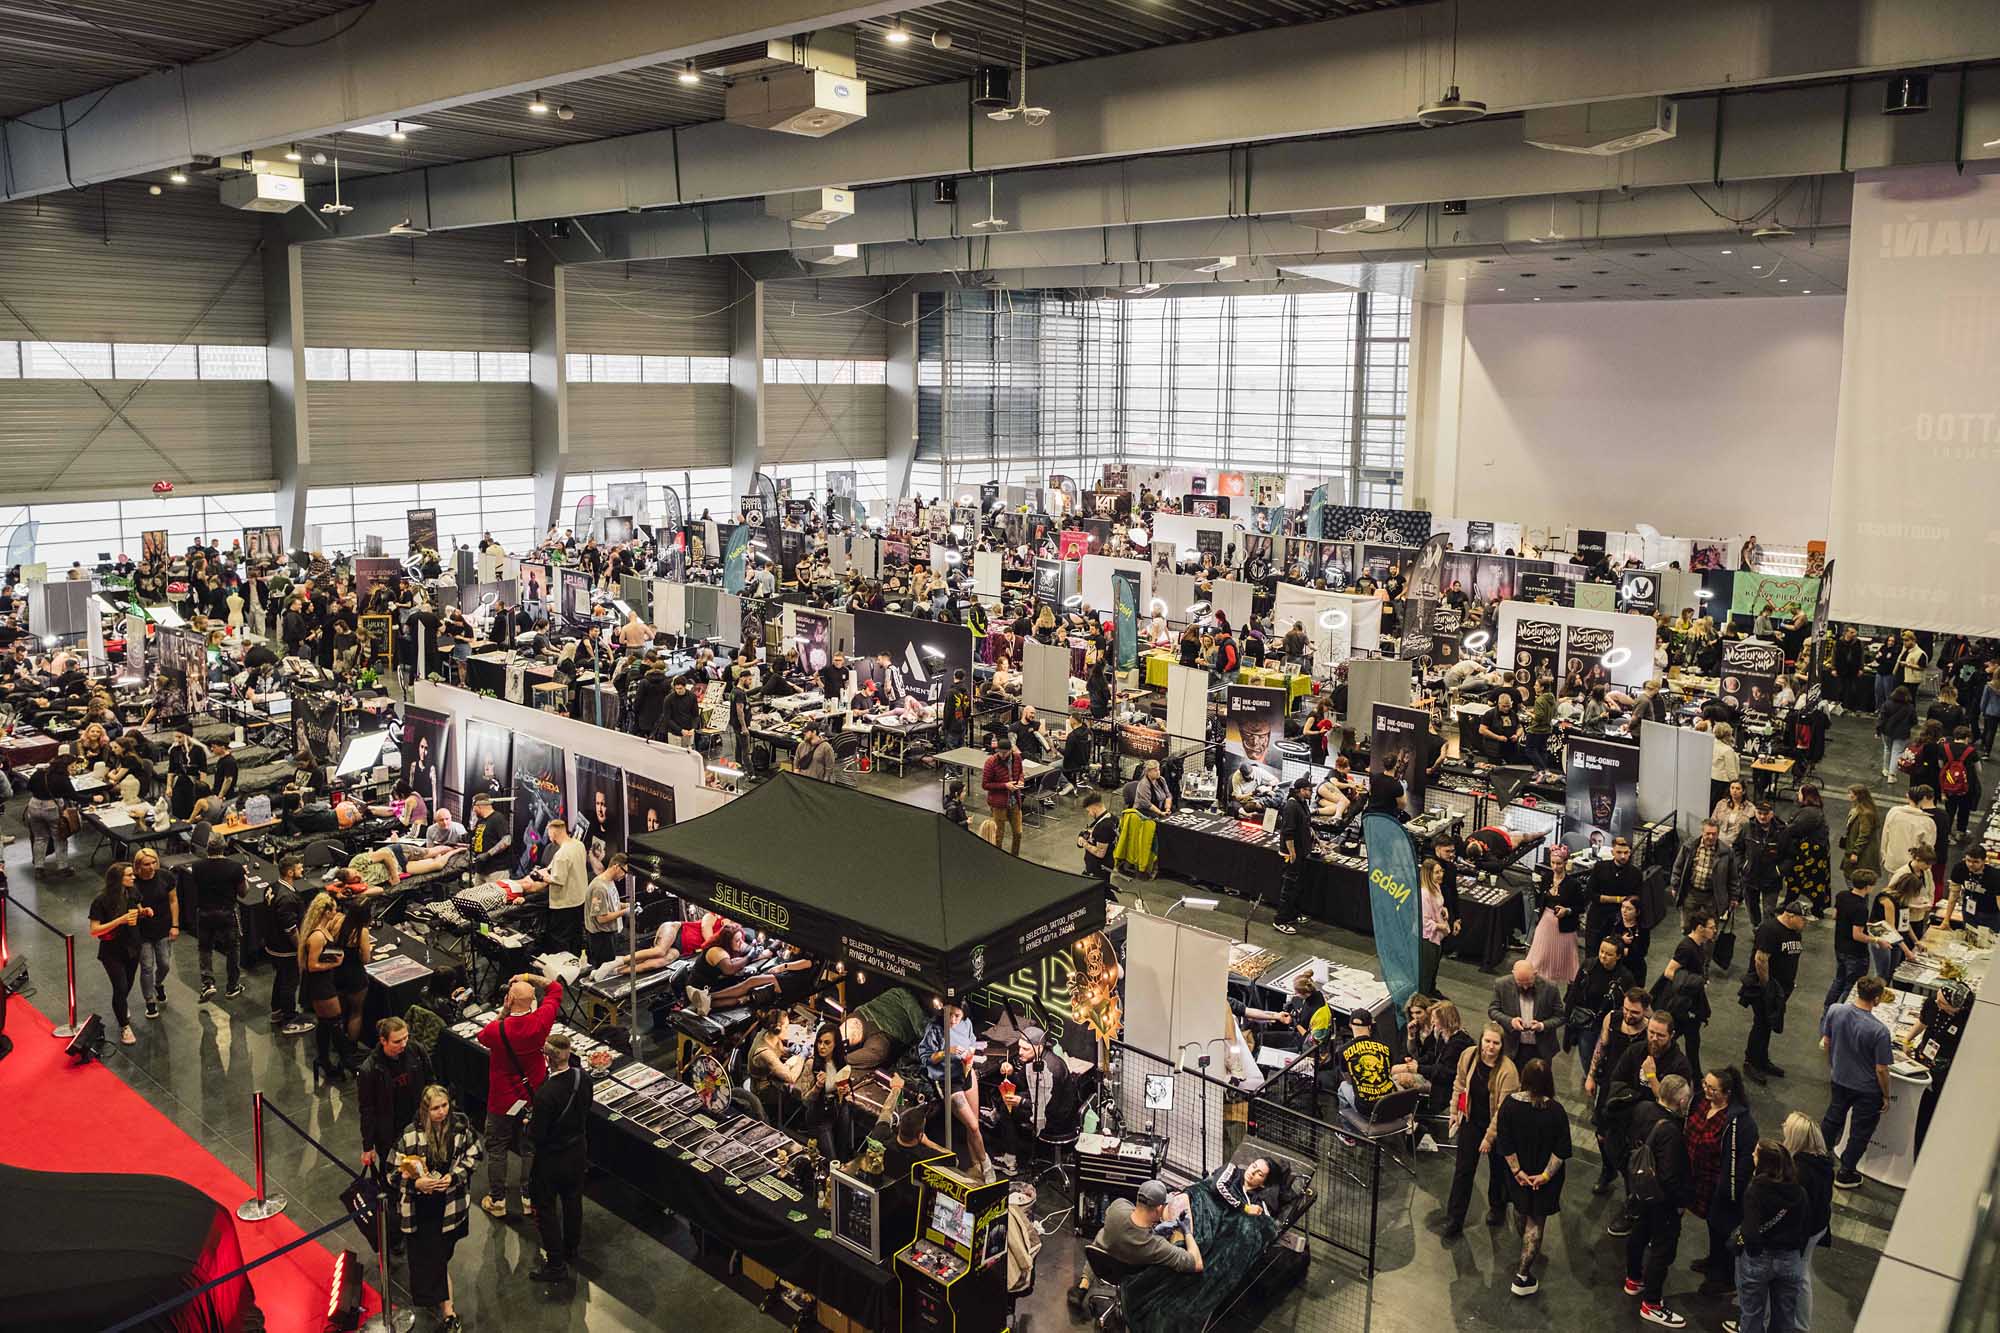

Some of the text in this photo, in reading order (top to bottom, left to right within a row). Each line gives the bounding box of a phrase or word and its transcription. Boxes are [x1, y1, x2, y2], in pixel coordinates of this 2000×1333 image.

[1585, 755, 1620, 767] INK-OGNITO
[714, 881, 790, 926] SELECTED
[848, 948, 868, 964] RYNEK
[885, 959, 906, 977] ŻAGAŃ
[1343, 1040, 1390, 1061] BOUNDERS
